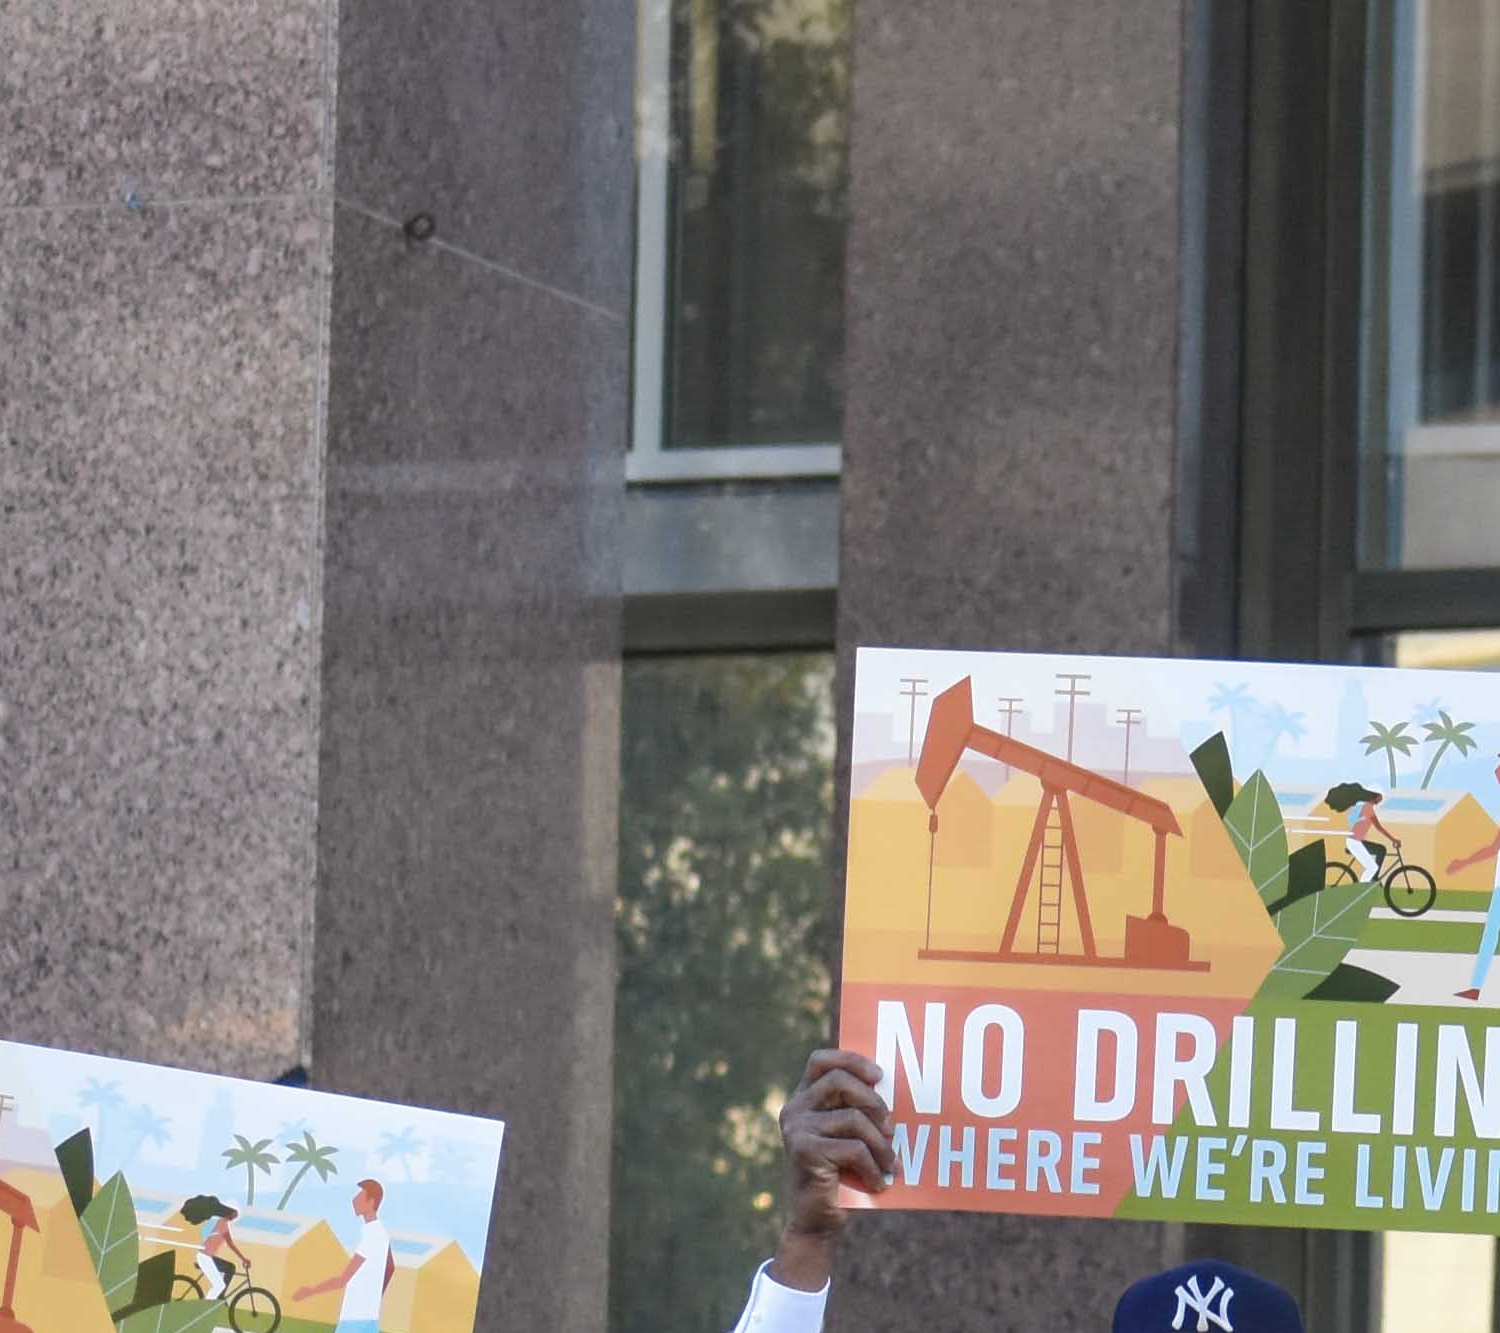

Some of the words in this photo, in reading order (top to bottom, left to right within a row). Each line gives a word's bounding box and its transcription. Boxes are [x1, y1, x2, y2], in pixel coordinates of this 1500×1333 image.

[874, 1001, 1025, 1119] NO
[883, 1123, 1101, 1196] WHERE
[1130, 1132, 1325, 1206] WE'RE
[1171, 1274, 1234, 1333] NY
